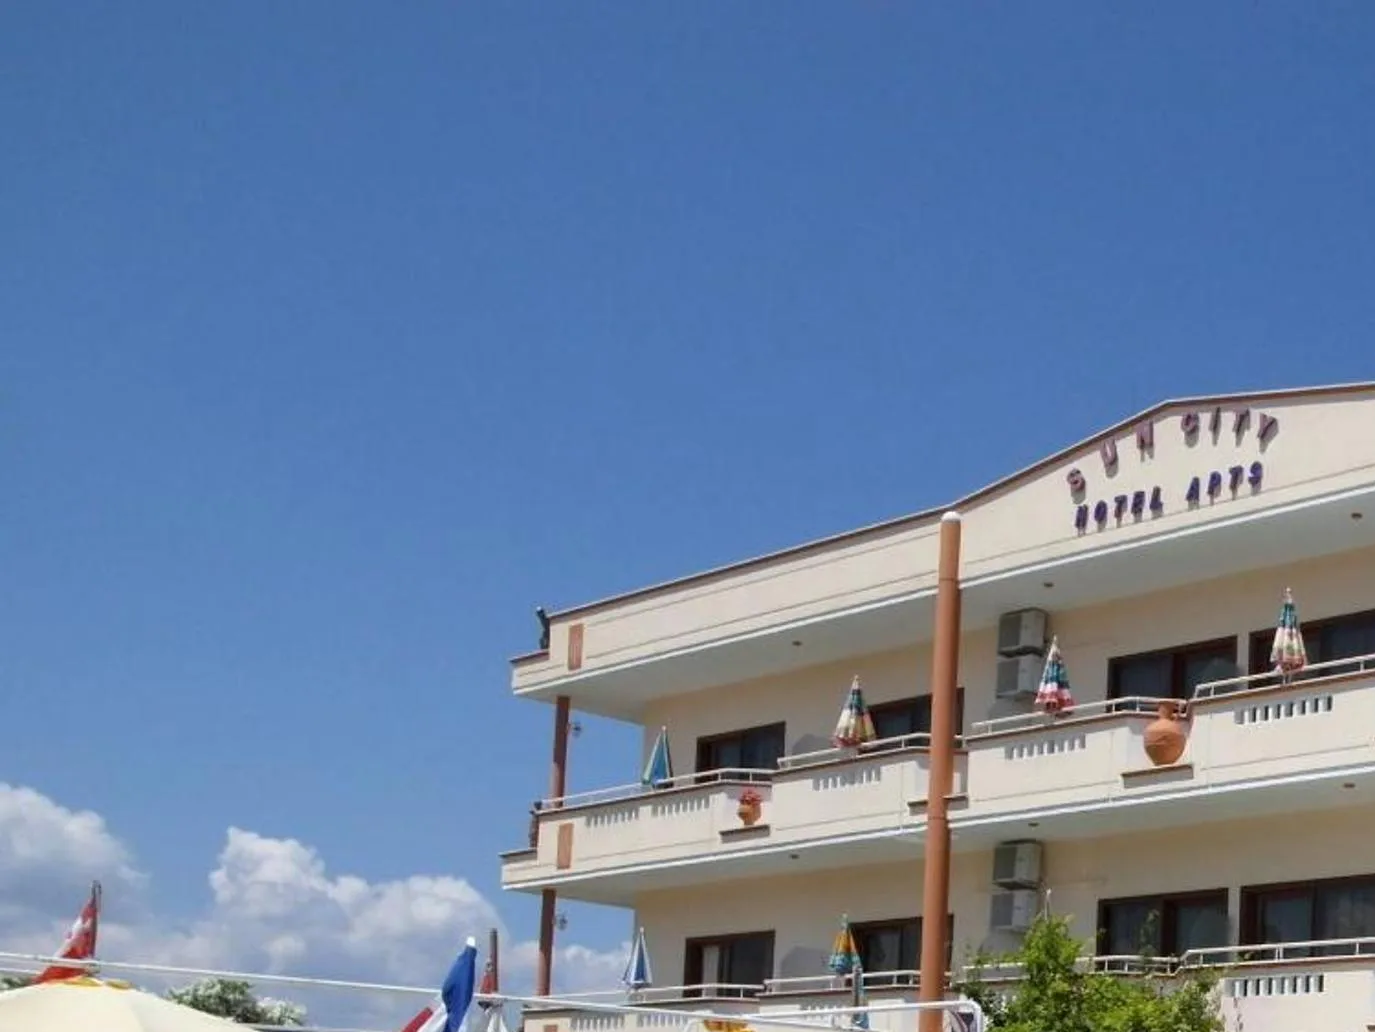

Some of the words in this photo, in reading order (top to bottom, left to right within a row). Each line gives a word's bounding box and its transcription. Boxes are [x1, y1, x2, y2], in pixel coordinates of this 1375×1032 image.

[1066, 419, 1154, 494] SUN
[1181, 407, 1279, 438] CITY
[1075, 487, 1163, 530] HOTEL
[1187, 461, 1263, 501] APTS
